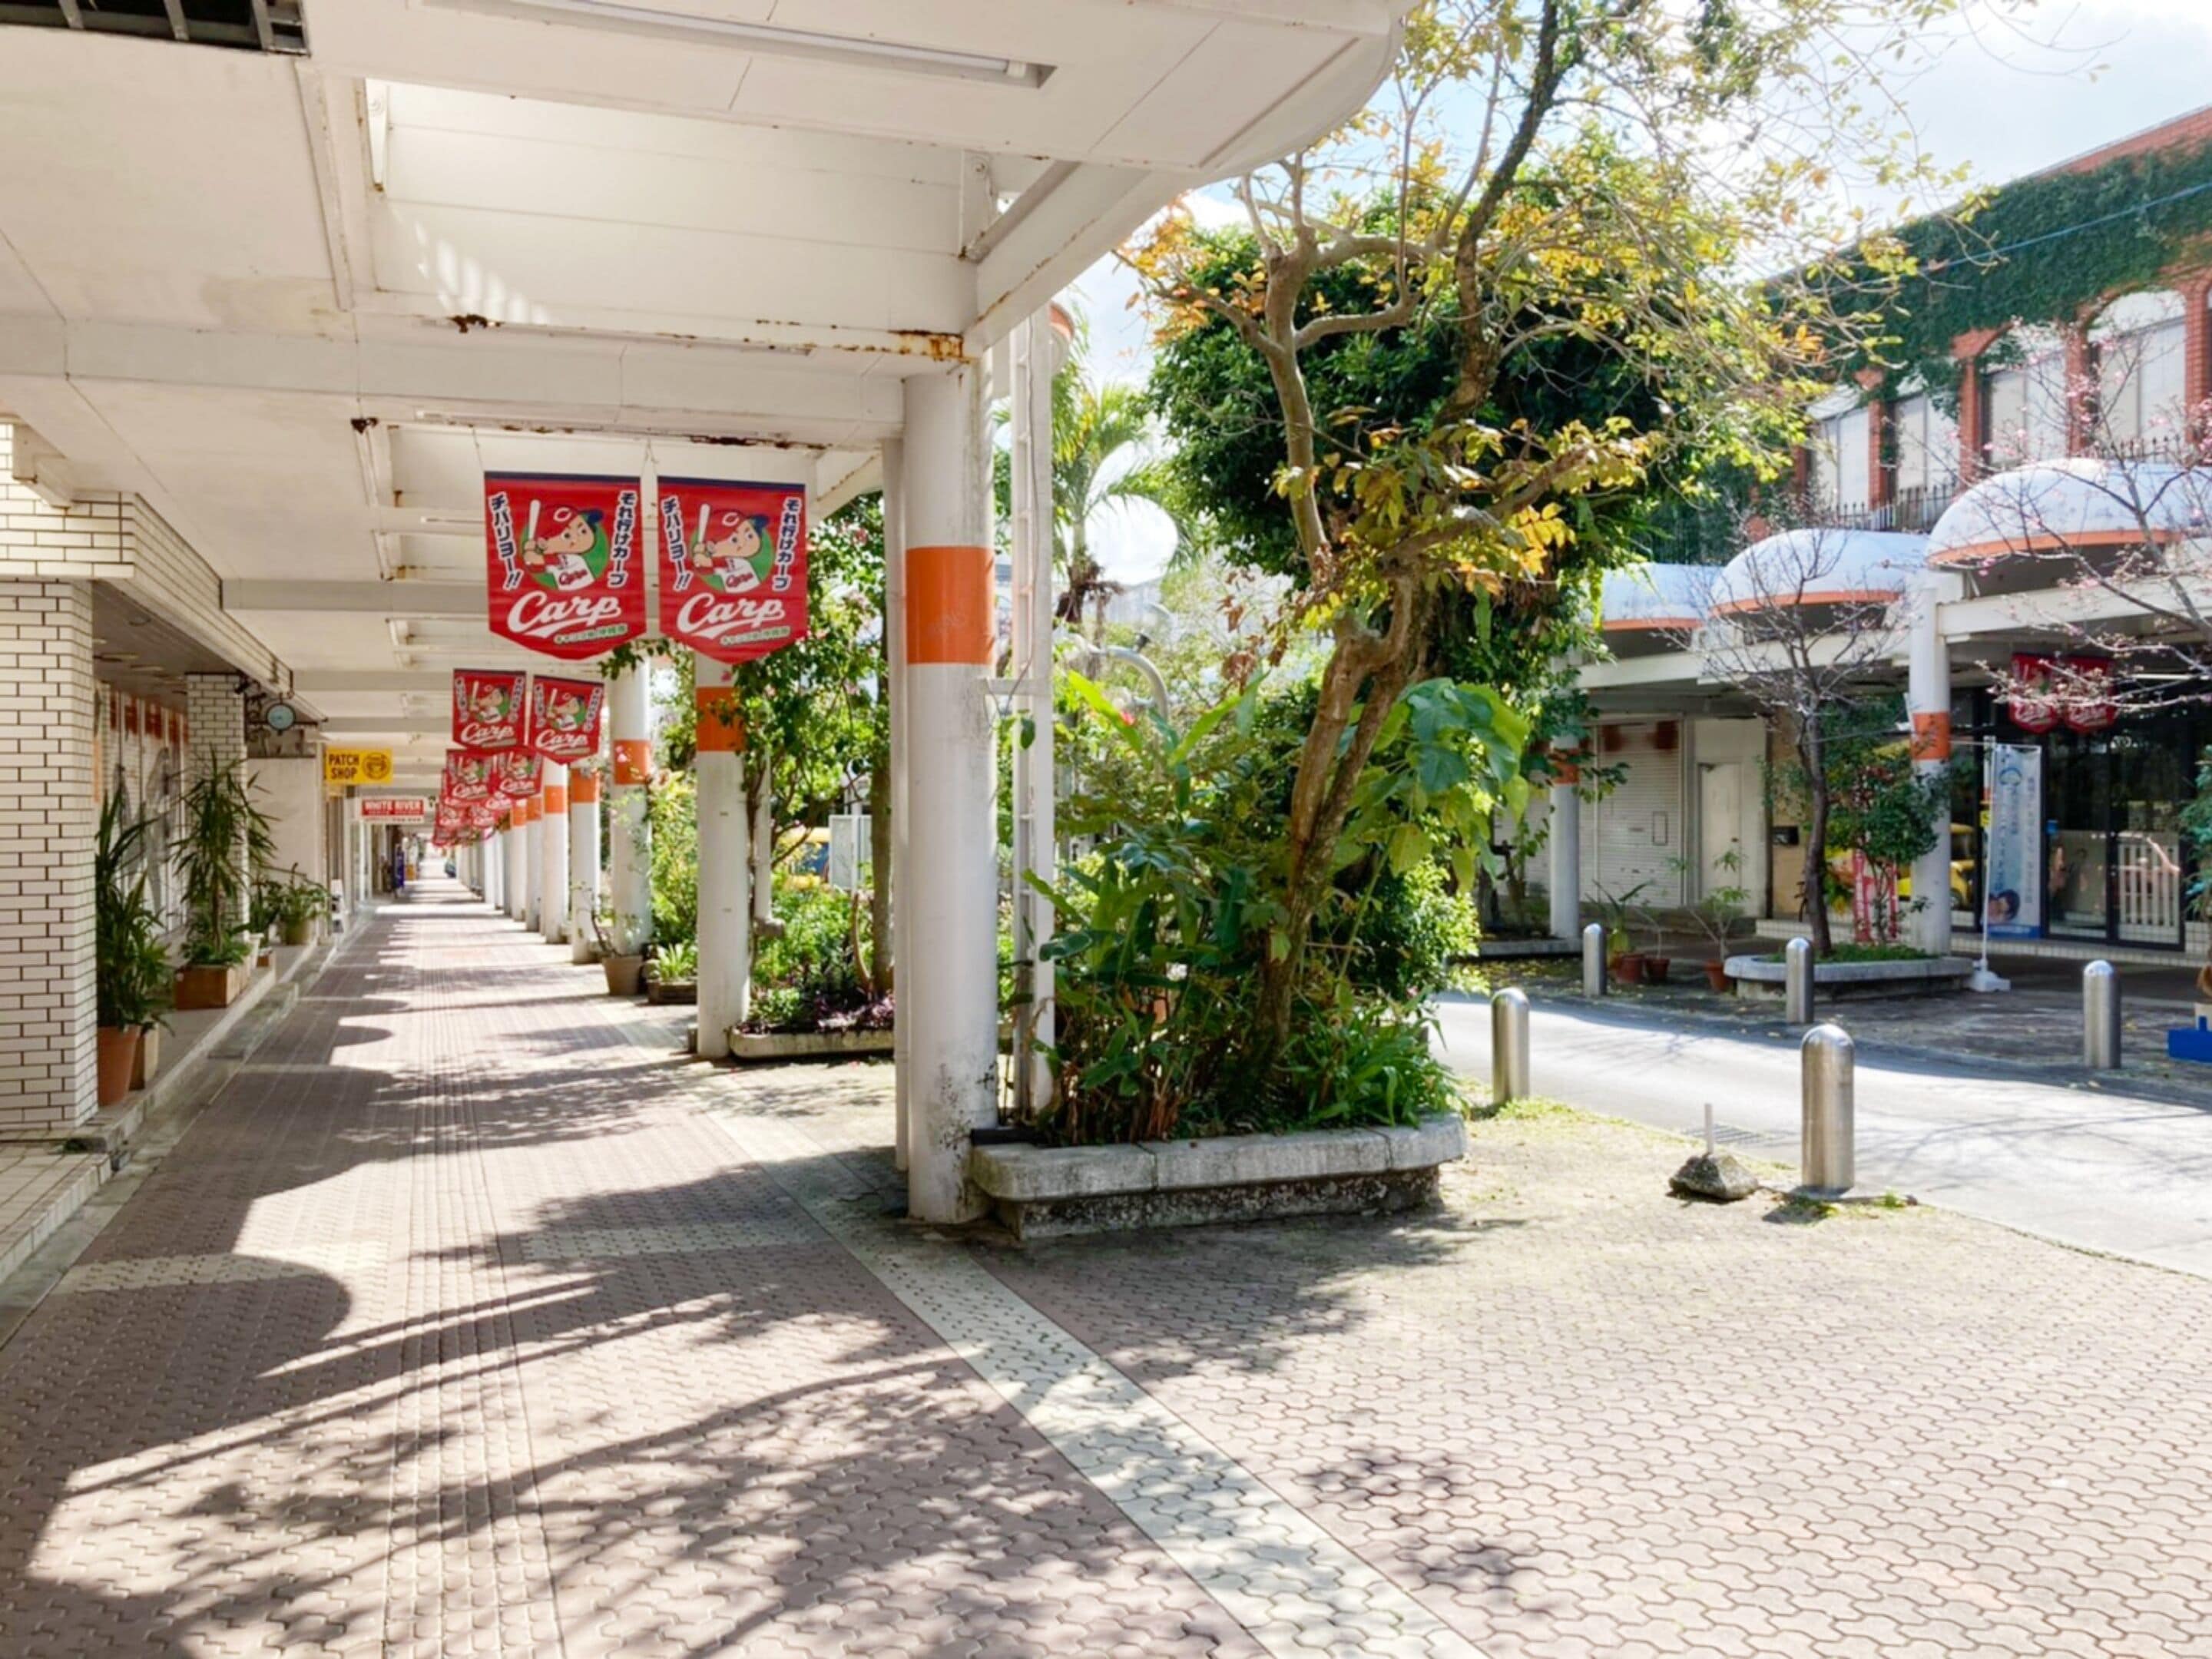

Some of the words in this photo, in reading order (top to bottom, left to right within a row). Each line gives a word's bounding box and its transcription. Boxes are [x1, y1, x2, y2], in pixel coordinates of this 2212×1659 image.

[610, 492, 637, 587] それ行けカープ
[773, 499, 800, 589] それ行けカープ
[507, 591, 622, 639] Carp
[677, 592, 786, 640] Carp
[461, 722, 515, 745] Carp
[535, 730, 589, 752] Carp
[329, 754, 359, 765] PATCH
[331, 768, 357, 779] SHOP
[364, 800, 392, 811] WHITE
[395, 800, 422, 811] RIVER
